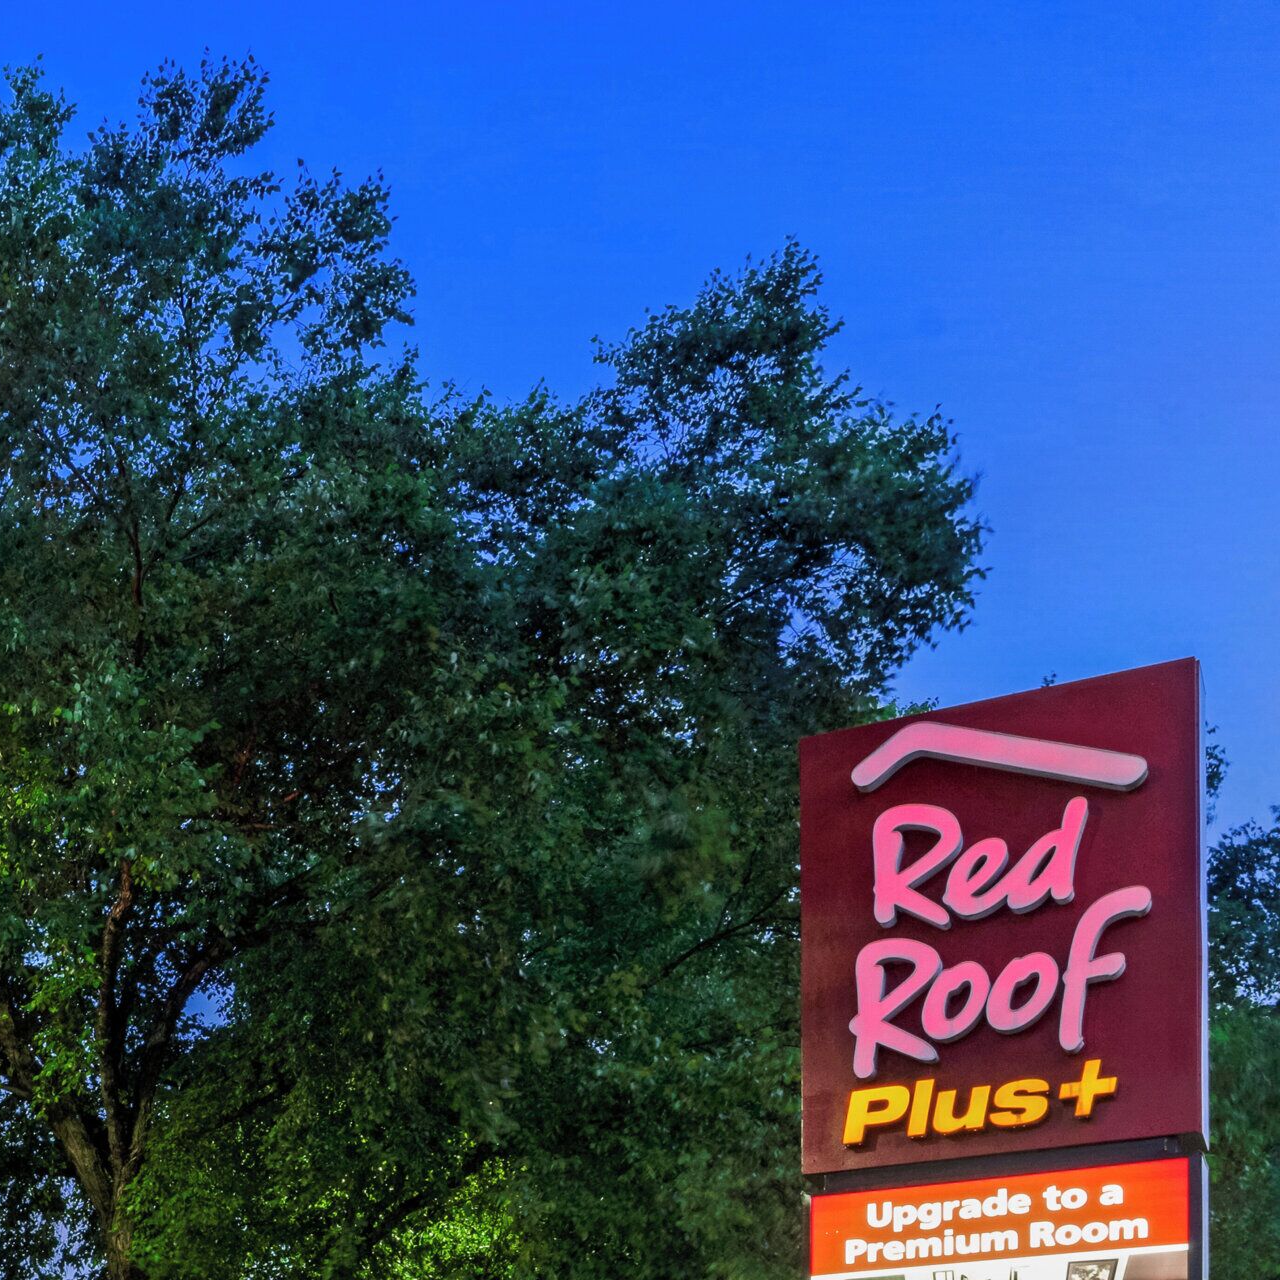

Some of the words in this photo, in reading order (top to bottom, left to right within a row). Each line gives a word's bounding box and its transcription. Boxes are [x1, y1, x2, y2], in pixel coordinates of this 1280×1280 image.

[872, 796, 1089, 930] Red
[849, 885, 1152, 1079] Roof
[842, 1059, 1118, 1146] Plus+
[844, 1228, 1019, 1265] Premium
[1030, 1217, 1149, 1249] Room
[866, 1188, 1032, 1232] Upgrade
[1042, 1184, 1088, 1211] to
[1099, 1184, 1124, 1205] a
